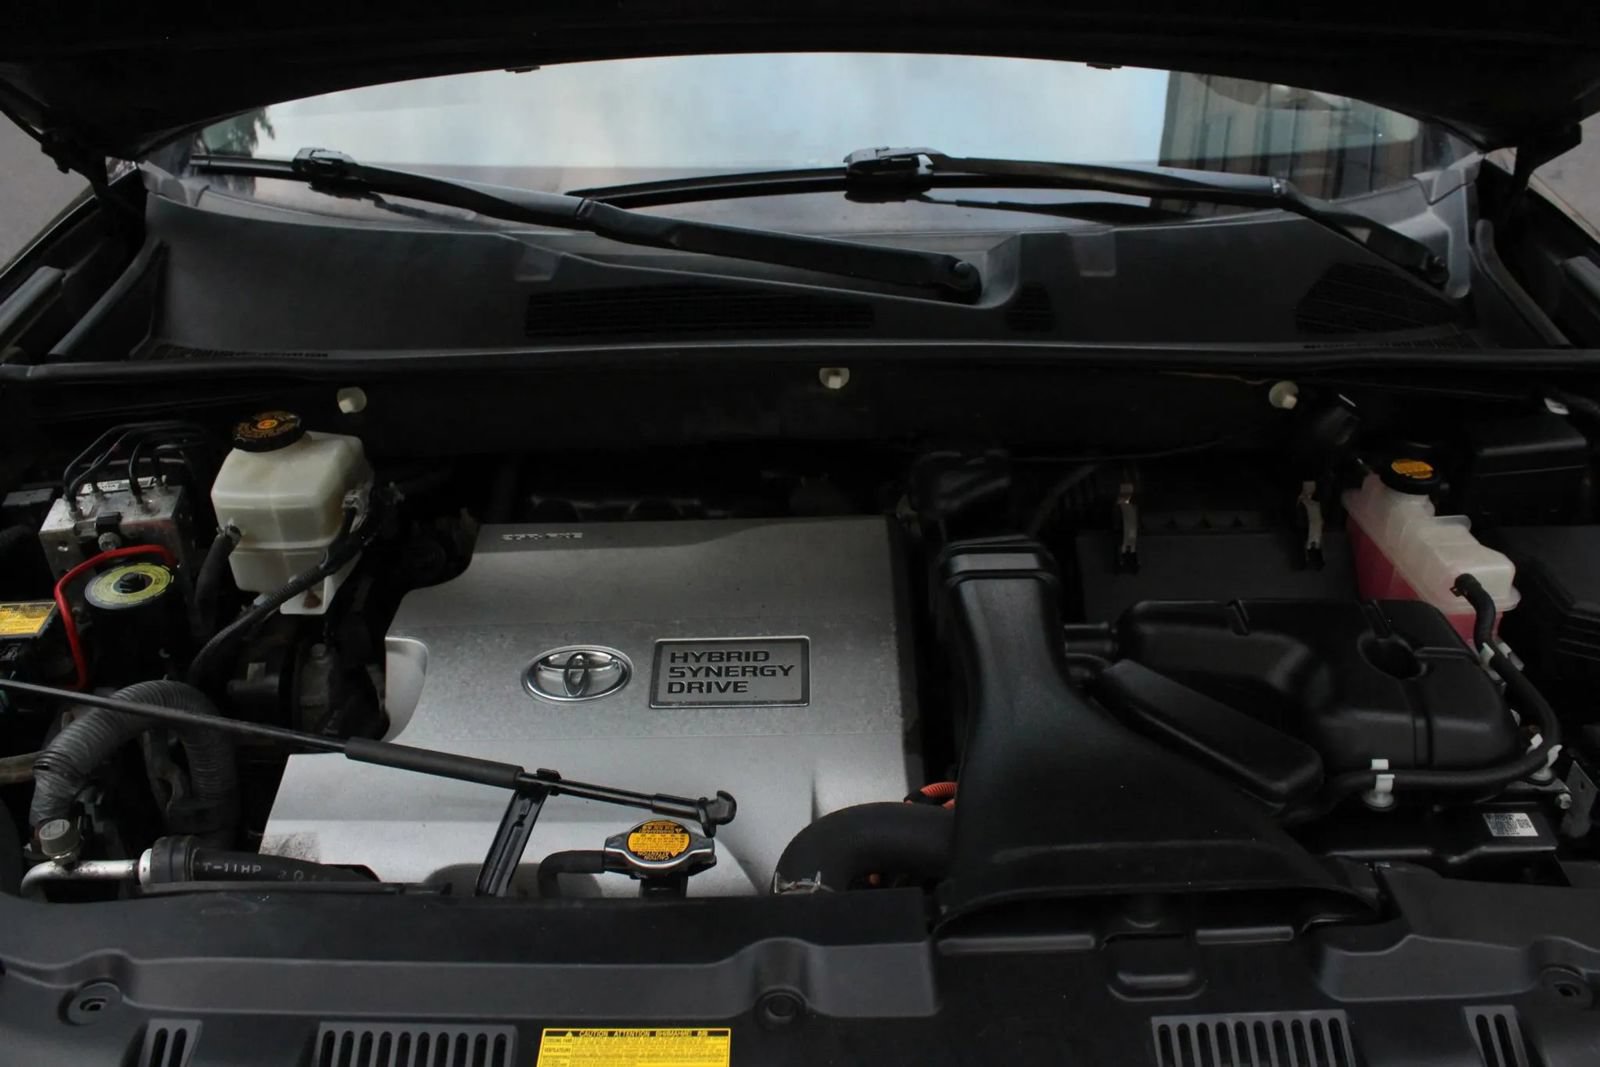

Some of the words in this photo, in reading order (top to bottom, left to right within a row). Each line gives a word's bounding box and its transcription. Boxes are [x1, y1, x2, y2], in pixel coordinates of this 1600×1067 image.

[669, 650, 770, 663] HYBRID
[668, 665, 795, 678] SYNERGY
[667, 680, 749, 694] DRIVE
